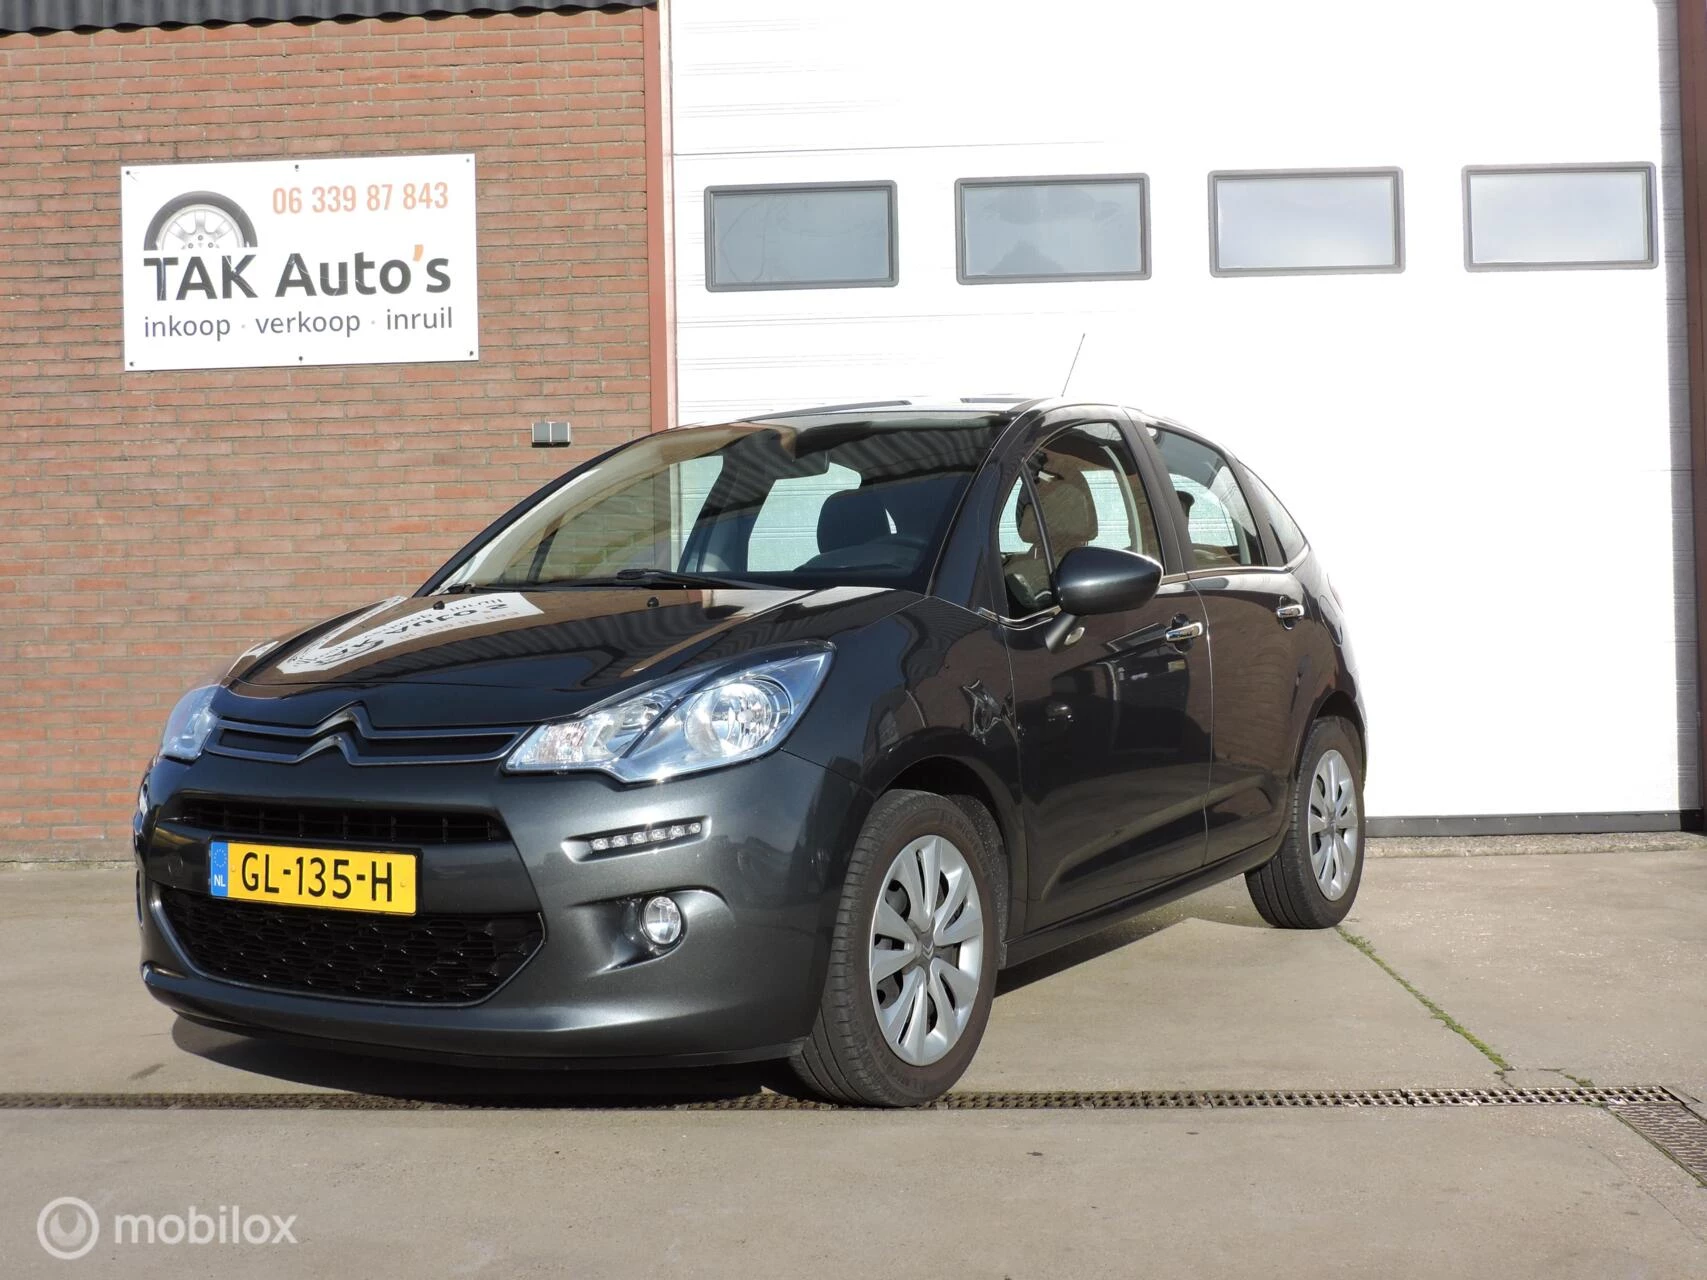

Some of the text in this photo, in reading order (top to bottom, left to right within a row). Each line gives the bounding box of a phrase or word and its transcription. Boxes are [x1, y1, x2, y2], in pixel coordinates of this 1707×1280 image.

[272, 182, 449, 214] 06 339 87 843
[143, 244, 451, 301] TAK Auto's
[144, 306, 453, 341] inkoop verkoop inruil
[213, 874, 226, 888] NL
[241, 851, 393, 902] GL-135-H
